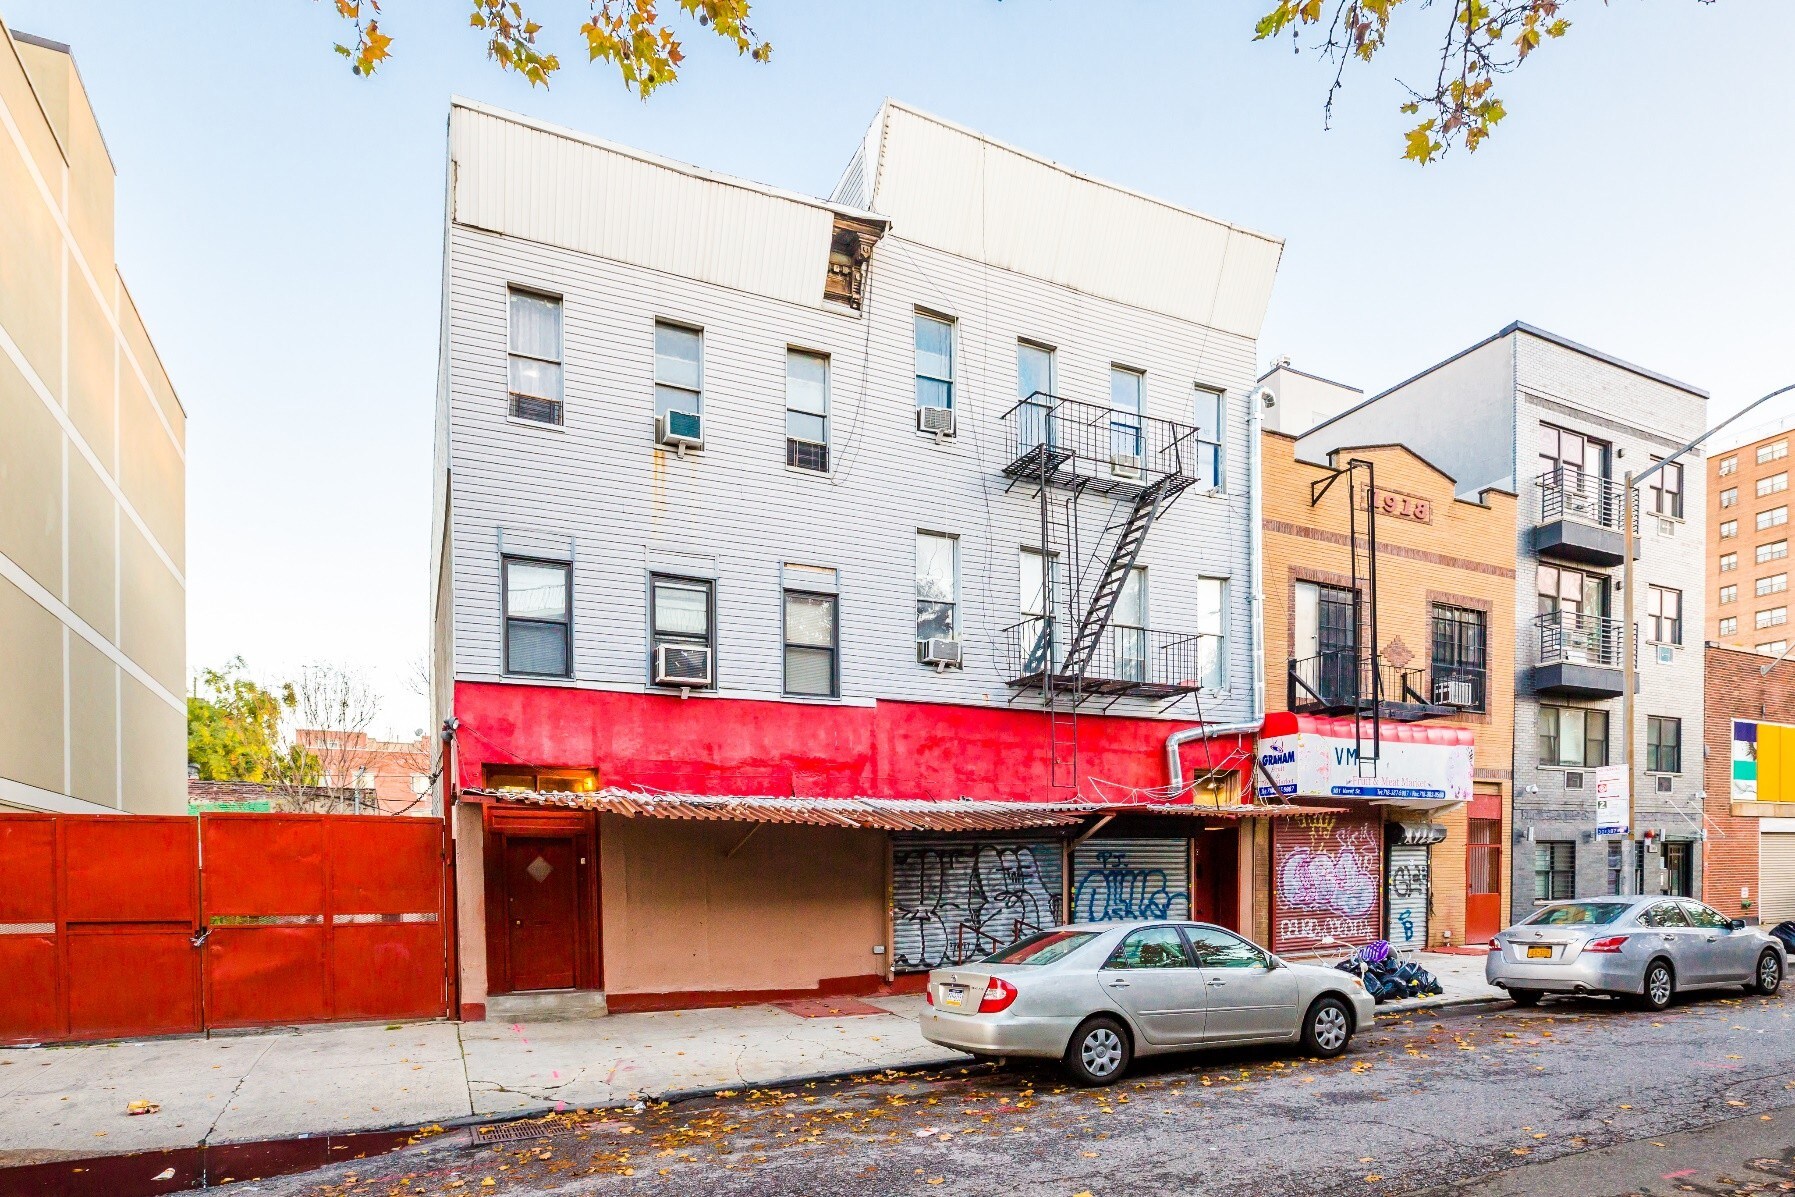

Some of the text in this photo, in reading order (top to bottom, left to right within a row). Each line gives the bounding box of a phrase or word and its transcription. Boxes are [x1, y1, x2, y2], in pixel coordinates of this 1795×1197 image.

[1372, 491, 1429, 519] 1918
[1262, 751, 1295, 766] GRAHAM
[1352, 776, 1427, 787] Fruit & Meat Market
